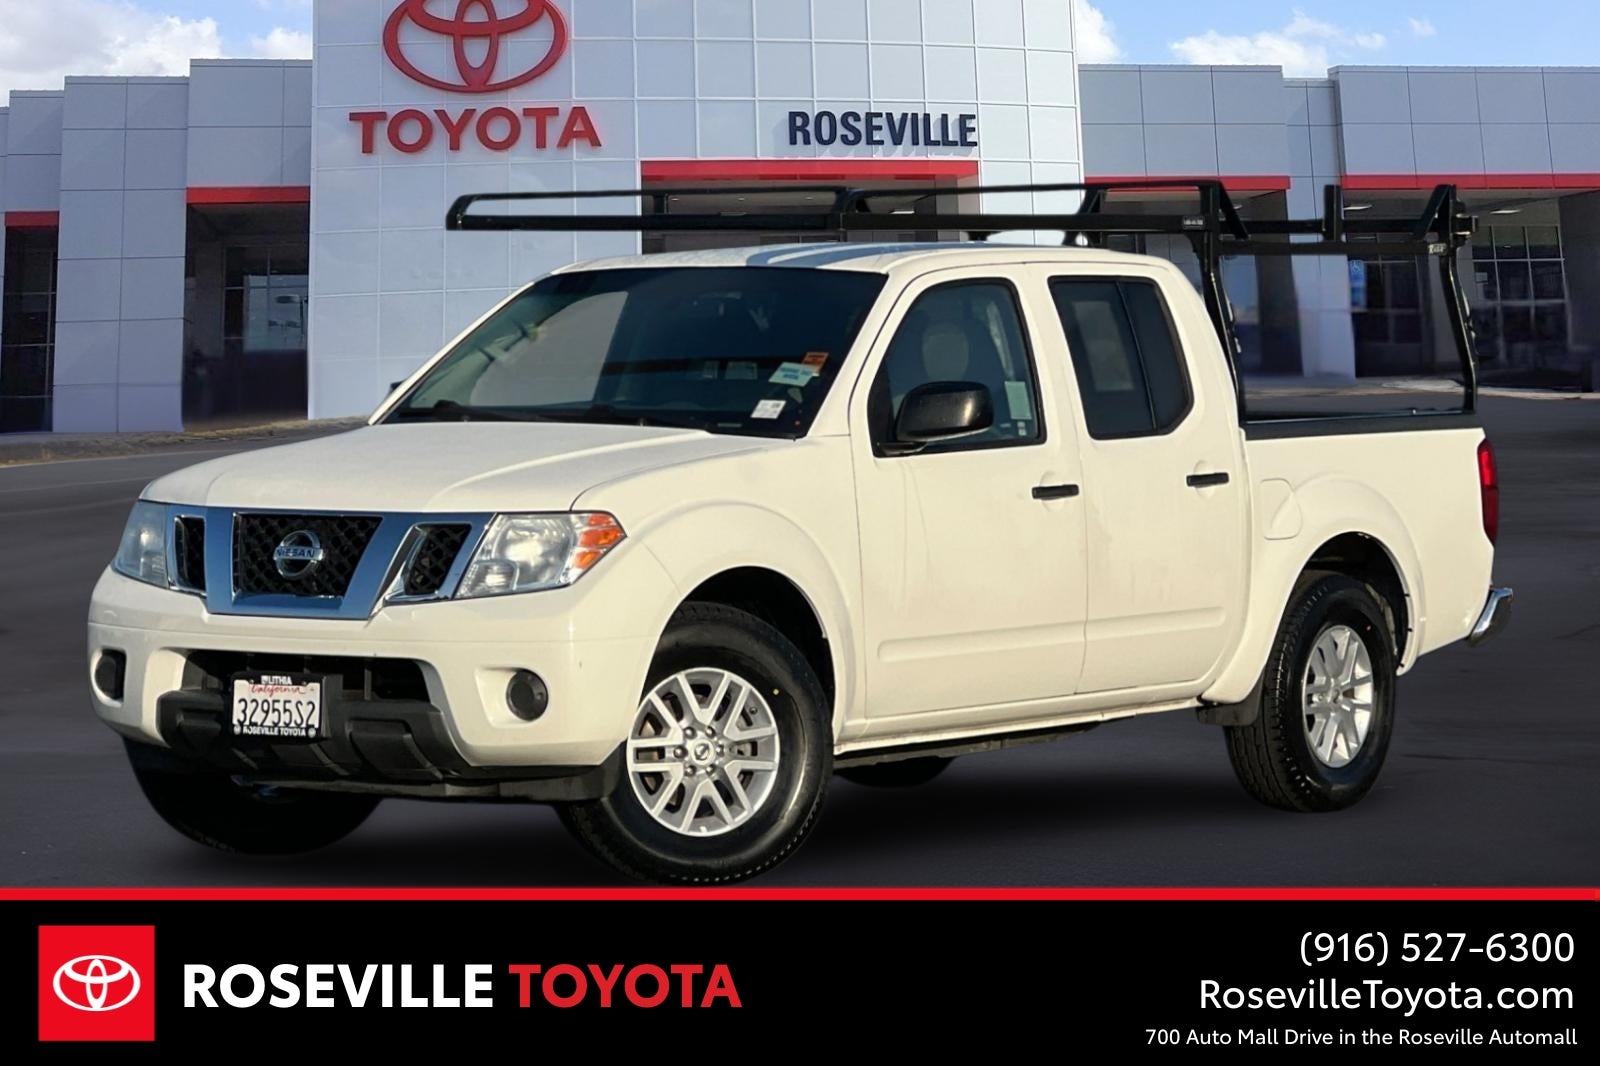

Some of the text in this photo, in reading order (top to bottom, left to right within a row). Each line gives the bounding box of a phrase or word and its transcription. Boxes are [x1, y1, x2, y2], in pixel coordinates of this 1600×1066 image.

[349, 106, 602, 154] TOYOTA
[788, 111, 978, 147] ROSEVILLE
[237, 698, 316, 728] 32955S2
[242, 726, 307, 737] ROSEVILLE TOYOTA
